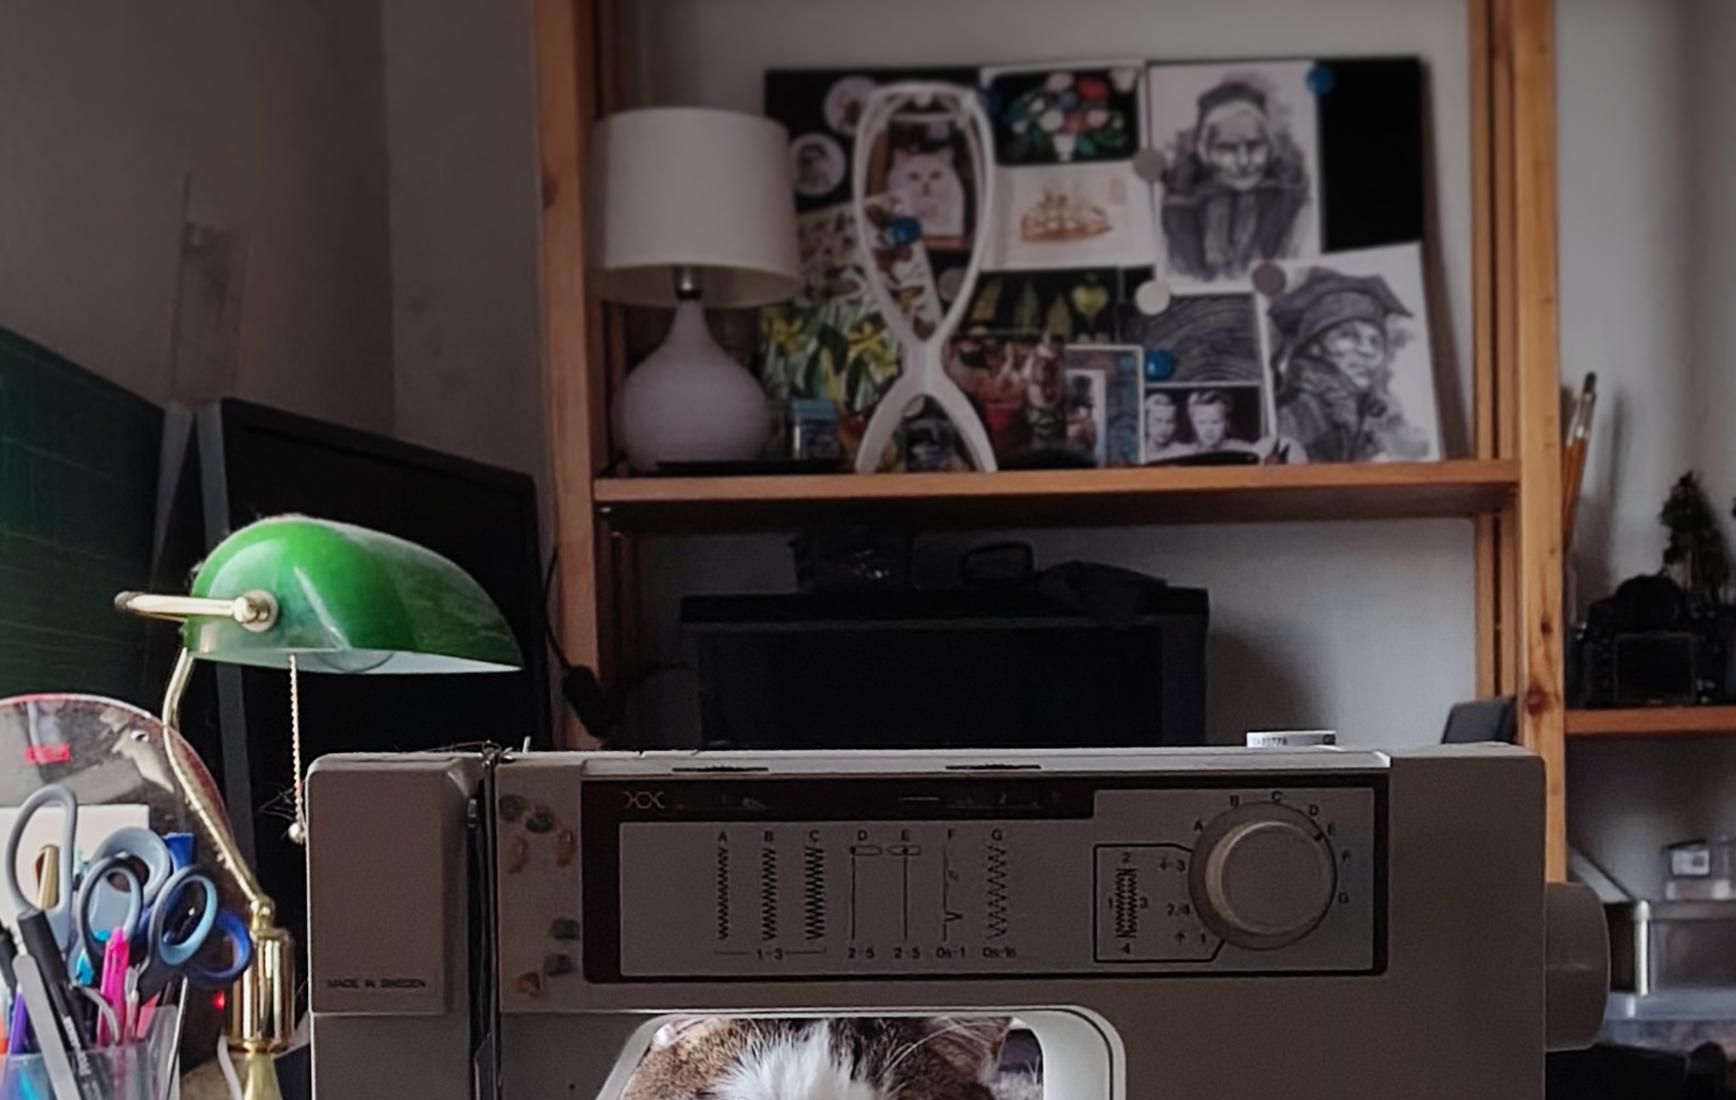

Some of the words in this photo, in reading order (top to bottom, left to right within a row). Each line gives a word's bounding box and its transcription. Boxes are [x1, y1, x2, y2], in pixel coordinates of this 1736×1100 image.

[718, 830, 728, 842] A
[808, 829, 820, 842] C
[857, 829, 868, 841] D
